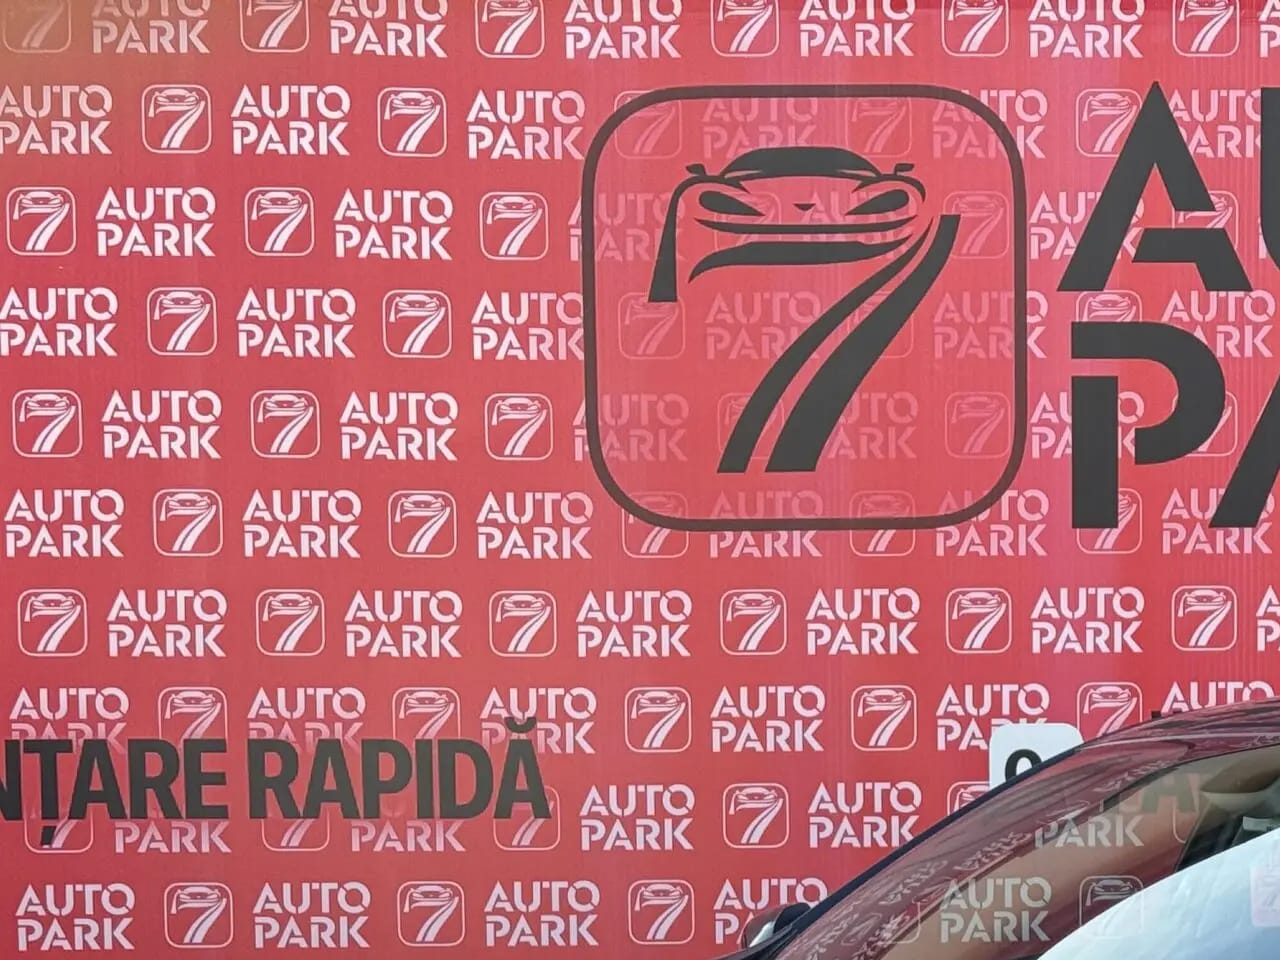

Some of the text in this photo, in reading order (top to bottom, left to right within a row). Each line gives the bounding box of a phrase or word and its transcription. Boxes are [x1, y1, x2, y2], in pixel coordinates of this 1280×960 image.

[92, 19, 212, 55] PARK
[330, 20, 448, 58] PARK
[564, 22, 683, 60] PARK
[799, 22, 914, 58] PARK
[1028, 23, 1144, 59] PARK
[0, 84, 113, 118] AUTO
[231, 85, 351, 120] AUTO
[466, 90, 585, 124] AUTO
[0, 120, 111, 155] PARK
[232, 120, 350, 156] PARK
[468, 125, 583, 160] PARK
[95, 186, 216, 221] AUTO
[333, 189, 453, 225] AUTO
[97, 222, 215, 257] PARK
[335, 224, 452, 260] PARK
[0, 287, 118, 321] AUTO
[236, 288, 356, 322] AUTO
[471, 292, 584, 325] AUTO
[1161, 290, 1276, 323] AUTO
[0, 322, 117, 357] PARK
[238, 323, 355, 358] PARK
[473, 326, 585, 361] PARK
[101, 389, 222, 424] AUTO
[339, 391, 458, 426] AUTO
[103, 425, 221, 459] PARK
[341, 426, 457, 461] PARK
[4, 488, 124, 522] AUTO
[242, 489, 362, 523] AUTO
[476, 492, 593, 524] AUTO
[6, 524, 123, 557] PARK
[244, 524, 360, 558] PARK
[477, 526, 592, 559] PARK
[935, 524, 1047, 557] PARK
[1162, 523, 1273, 555] PARK
[107, 589, 227, 622] AUTO
[344, 590, 463, 623] AUTO
[575, 590, 692, 623] AUTO
[805, 587, 920, 621] AUTO
[1030, 586, 1145, 619] AUTO
[108, 624, 226, 657] PARK
[346, 624, 461, 658] PARK
[577, 624, 691, 658] PARK
[807, 621, 919, 655] PARK
[1032, 620, 1142, 654] PARK
[9, 687, 130, 720] AUTO
[247, 686, 366, 720] AUTO
[480, 687, 597, 720] AUTO
[710, 685, 826, 718] AUTO
[936, 683, 1050, 716] AUTO
[712, 719, 823, 753] PARK
[247, 716, 552, 821] RAPIDĂ
[579, 783, 695, 817] AUTO
[807, 781, 922, 814] AUTO
[115, 822, 231, 853] PARK
[352, 821, 465, 852] PARK
[581, 818, 693, 851] PARK
[809, 815, 919, 848] PARK
[15, 882, 135, 916] AUTO
[252, 881, 371, 914] AUTO
[484, 880, 600, 913] AUTO
[17, 917, 135, 951] PARK
[254, 915, 370, 948] PARK
[485, 914, 599, 947] PARK
[940, 911, 1052, 943] PARK
